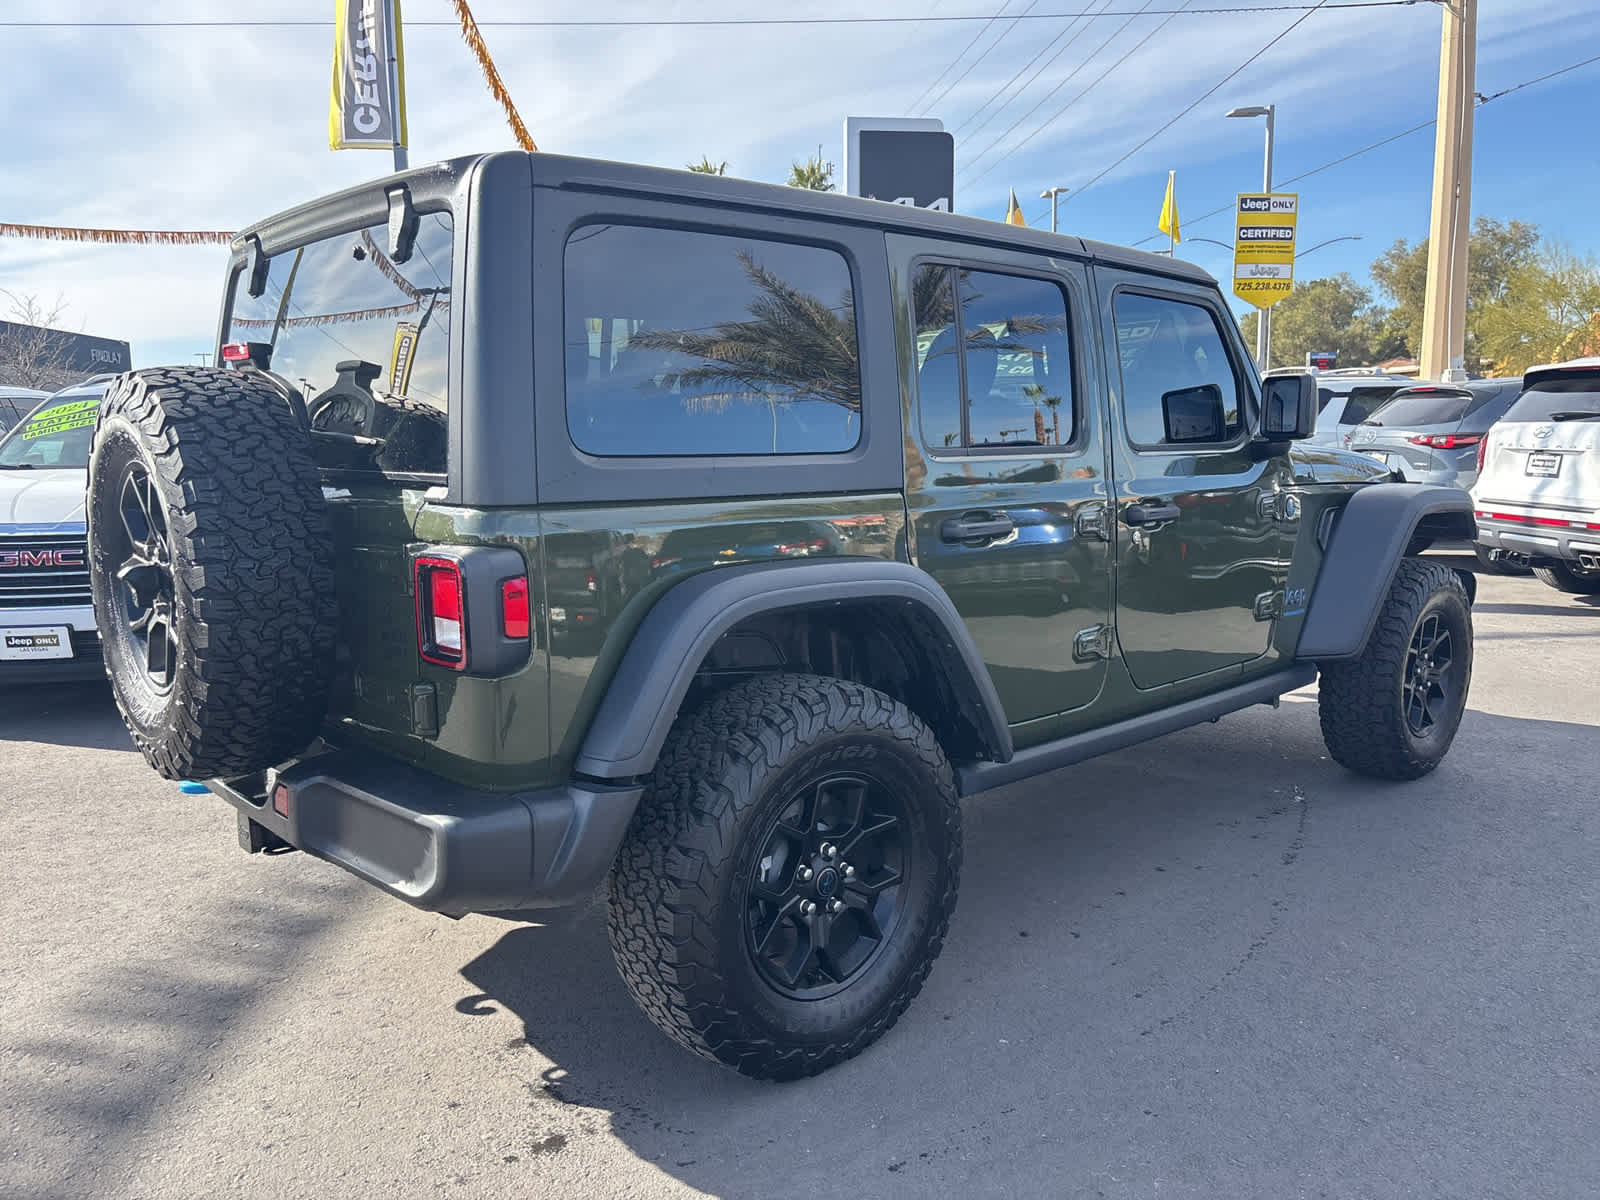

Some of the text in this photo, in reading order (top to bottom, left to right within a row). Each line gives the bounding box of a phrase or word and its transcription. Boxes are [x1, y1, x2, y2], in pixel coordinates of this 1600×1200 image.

[1242, 199, 1294, 210] Jeep ONLY
[1240, 229, 1292, 238] CERTIFIED
[45, 402, 88, 415] 2024
[23, 425, 61, 439] FAMILY
[0, 549, 84, 566] GMC
[8, 636, 57, 646] Jeep ONLY
